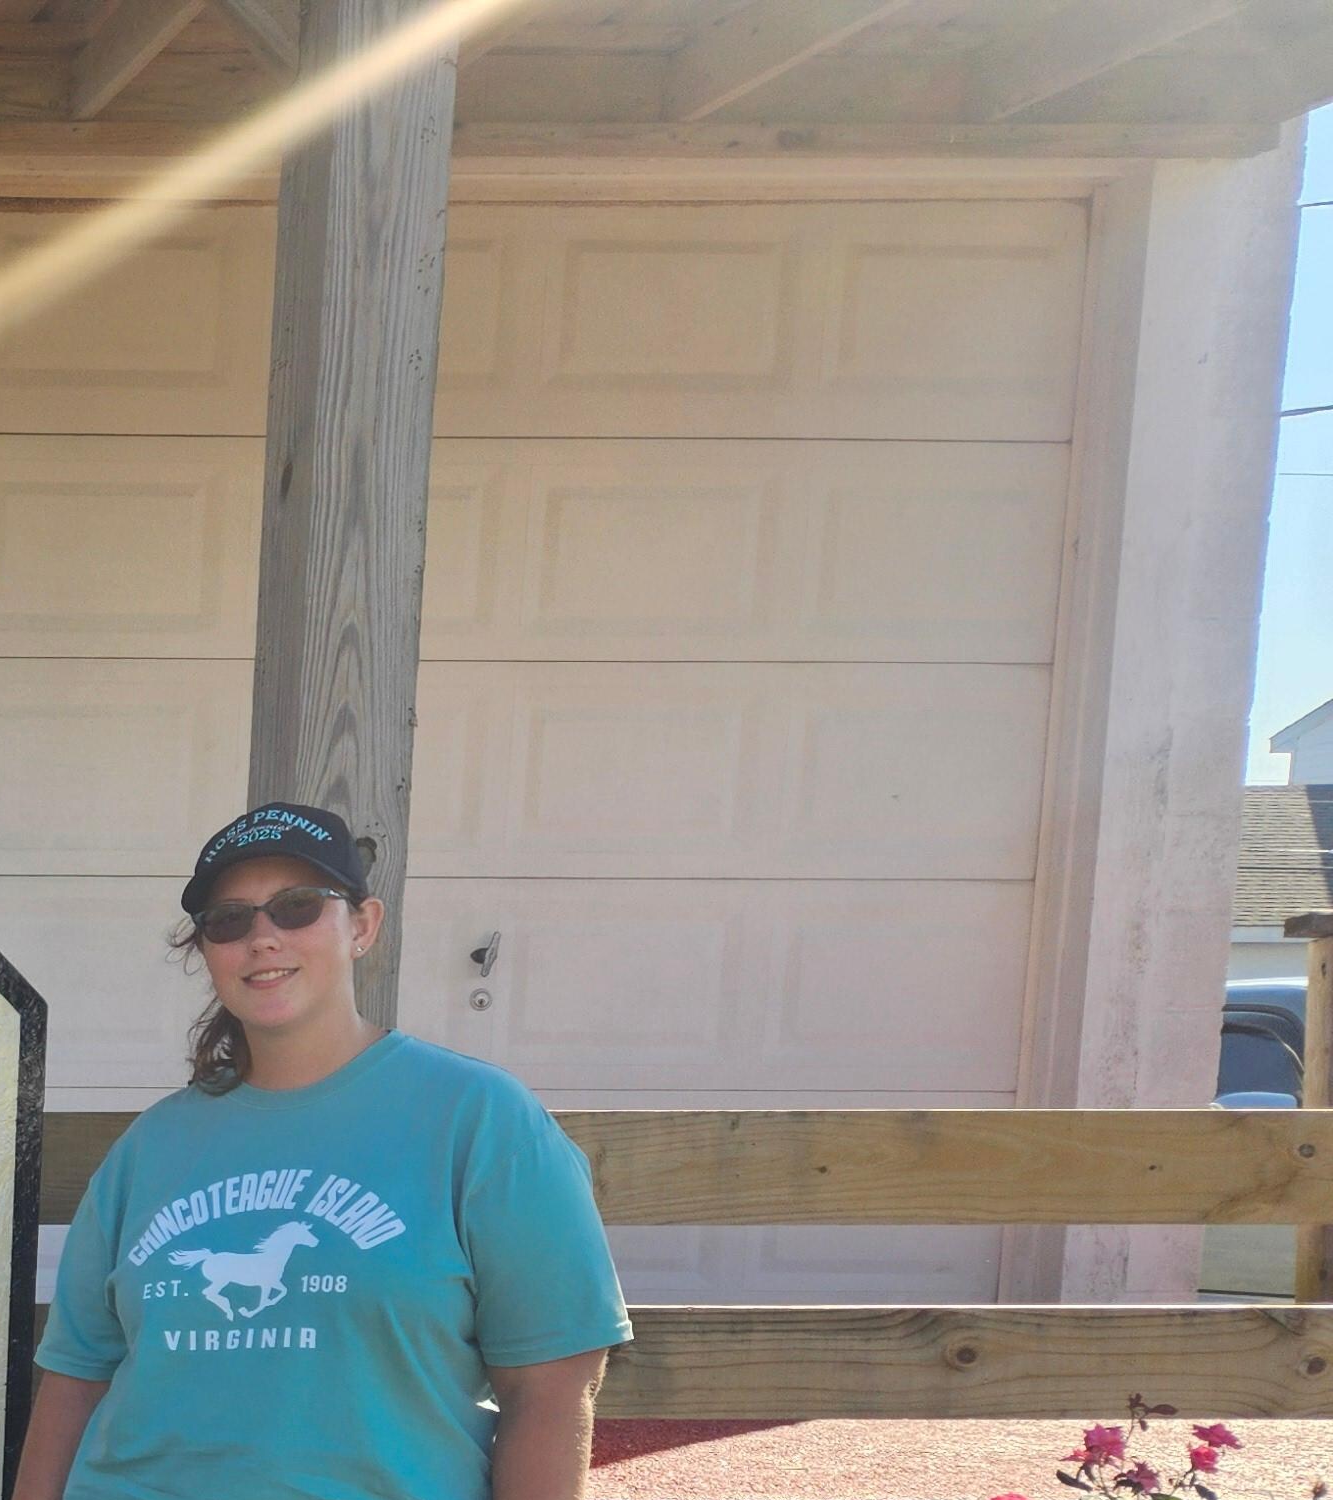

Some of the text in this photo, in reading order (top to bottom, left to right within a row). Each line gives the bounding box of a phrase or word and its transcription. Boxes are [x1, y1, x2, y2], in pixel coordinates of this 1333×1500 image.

[205, 809, 333, 862] HOSS PENNIN'
[237, 829, 282, 847] 2025
[128, 1169, 406, 1267] CHINCOTEAGUE ISLAND
[142, 1274, 348, 1300] EST. 1908
[164, 1327, 317, 1352] VIRGINIA
